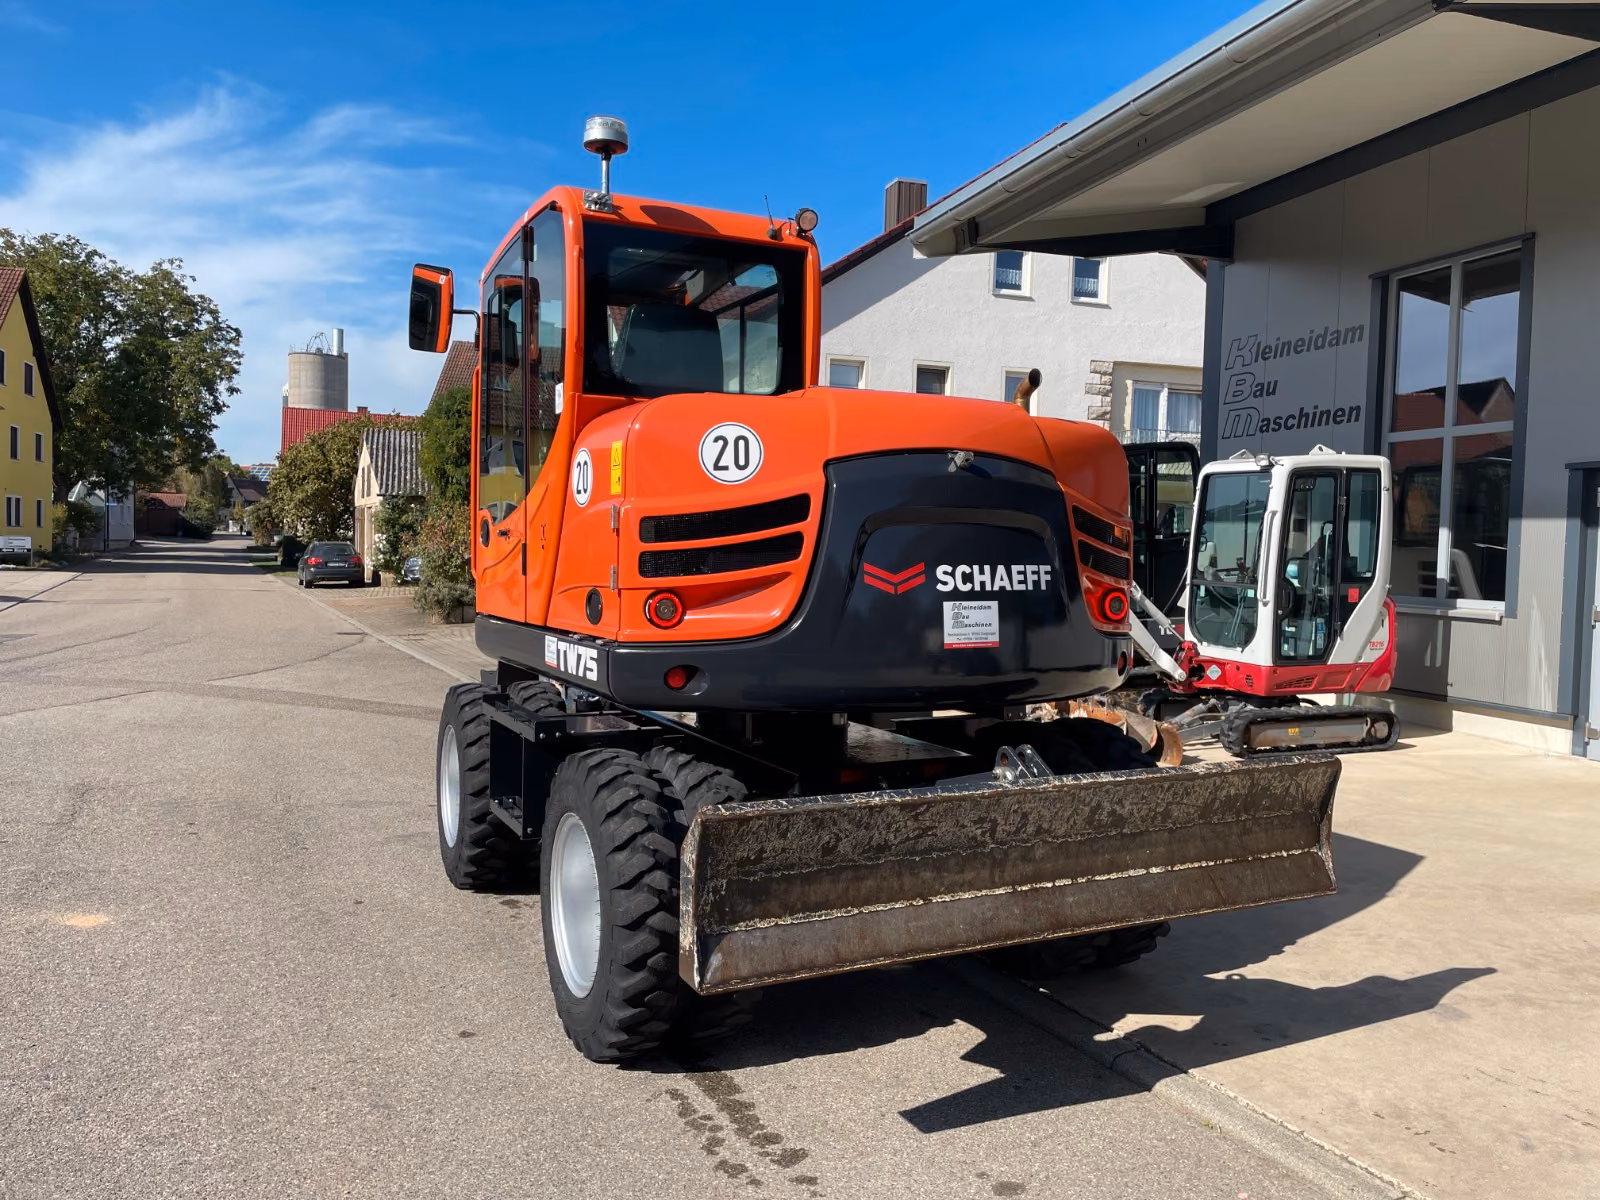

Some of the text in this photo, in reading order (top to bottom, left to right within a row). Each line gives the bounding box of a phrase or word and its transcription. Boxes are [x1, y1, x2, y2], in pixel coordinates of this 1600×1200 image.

[1225, 324, 1365, 371] Kleineidam
[1223, 372, 1279, 405] Bau
[1222, 404, 1362, 439] Maschinen
[712, 434, 750, 472] 20
[575, 460, 589, 496] 20
[935, 564, 1052, 592] SCHAEFF
[951, 602, 992, 611] Kleineidam
[951, 611, 970, 620] Bau
[951, 620, 993, 629] Maschinen
[557, 640, 598, 682] TW75
